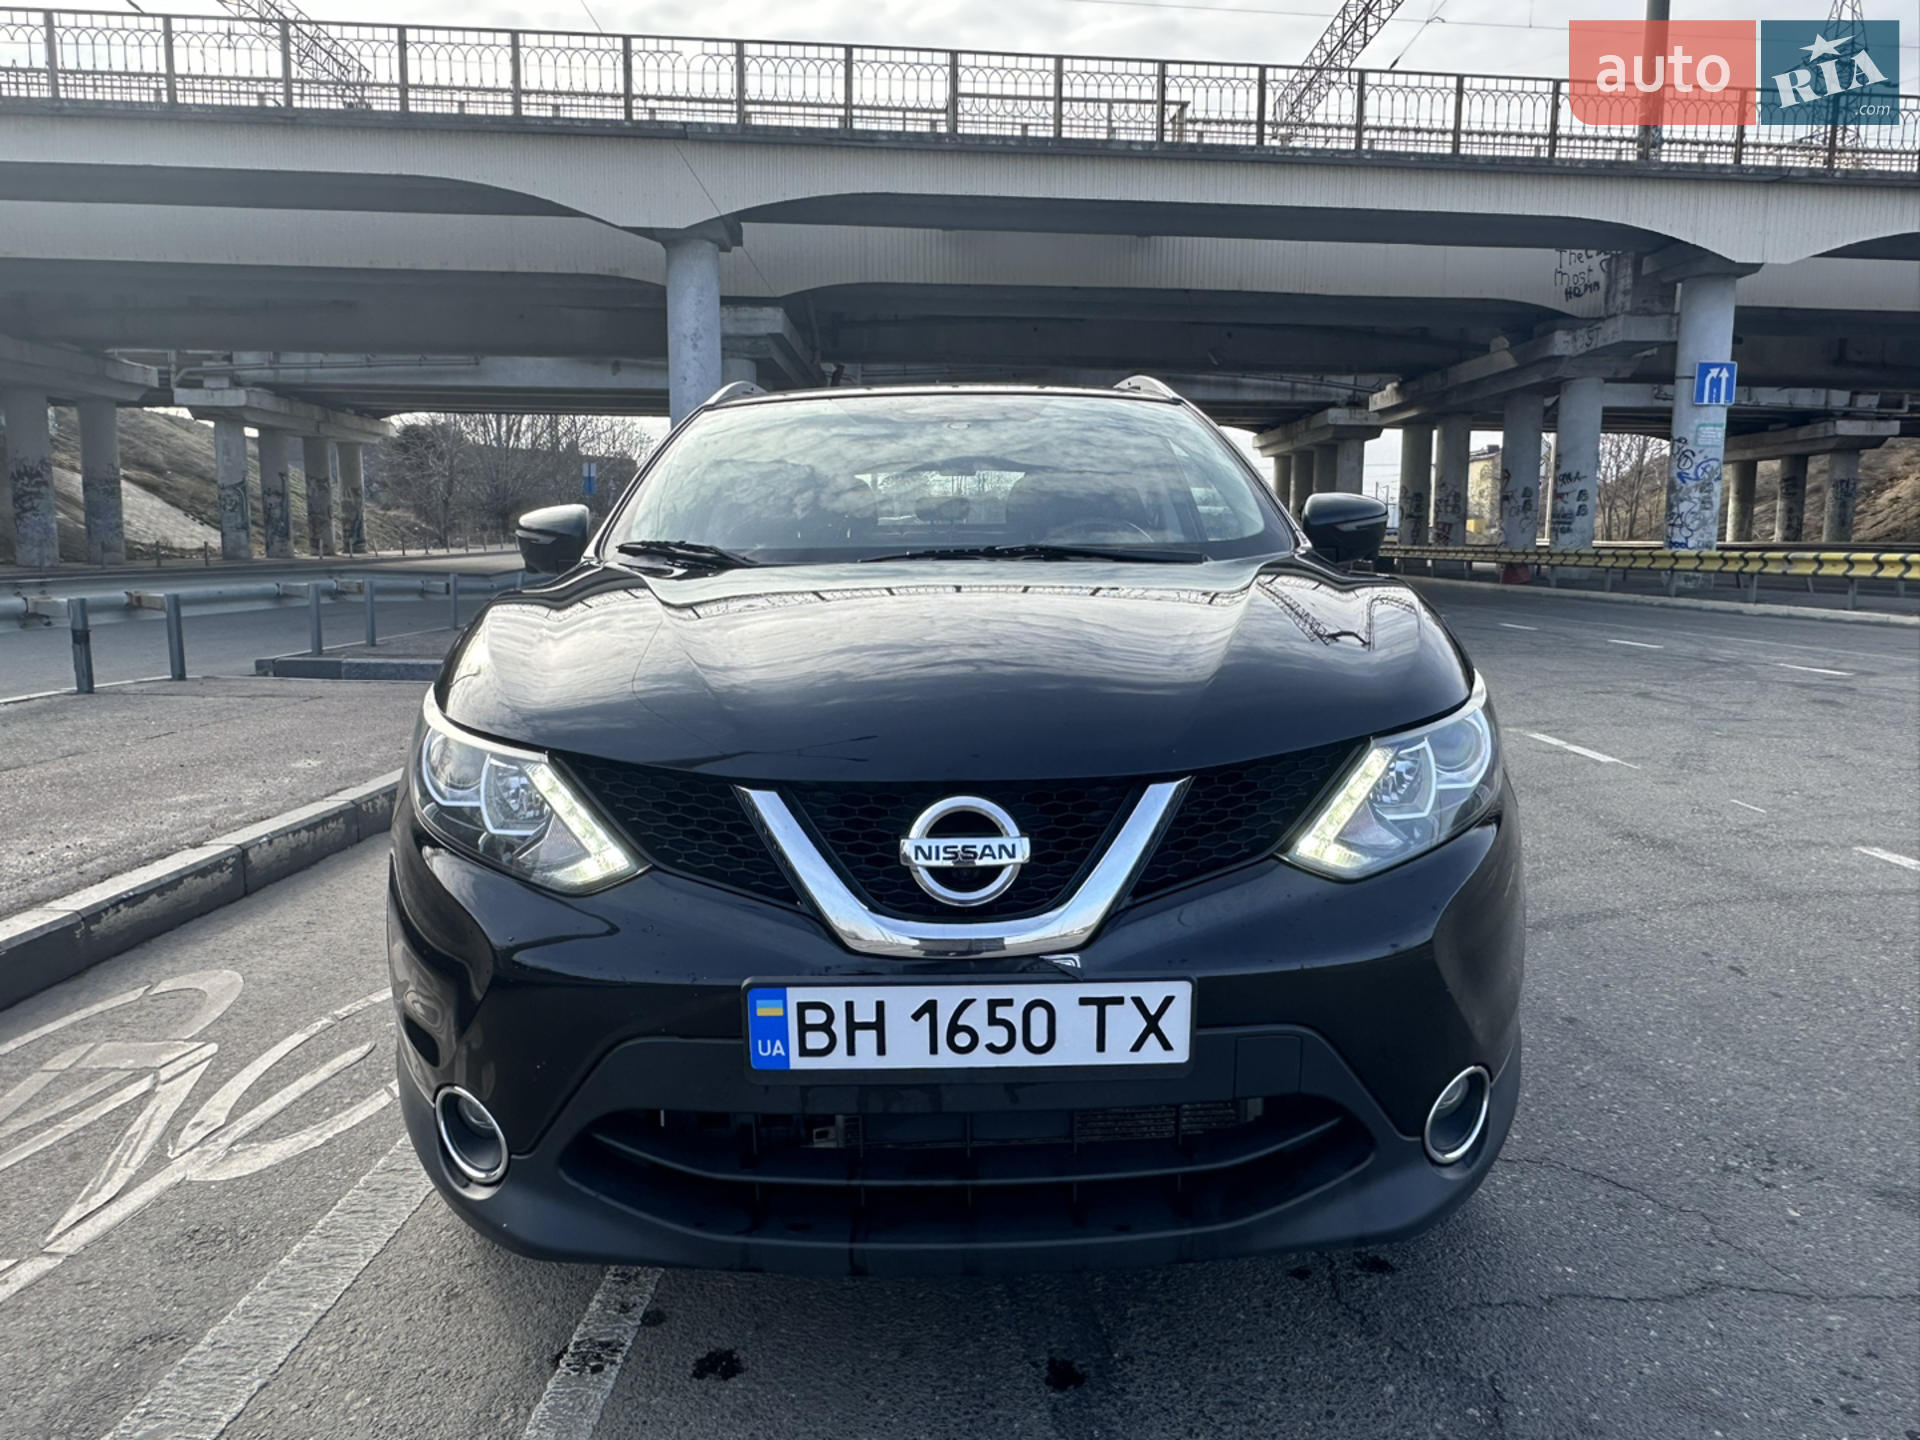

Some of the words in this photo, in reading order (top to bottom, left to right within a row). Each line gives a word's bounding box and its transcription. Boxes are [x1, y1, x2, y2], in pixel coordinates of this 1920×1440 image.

[914, 843, 1017, 861] NISSAN
[796, 1000, 887, 1058] BH
[910, 998, 1056, 1055] 1650
[1078, 995, 1176, 1053] TX
[757, 1039, 786, 1057] UA
